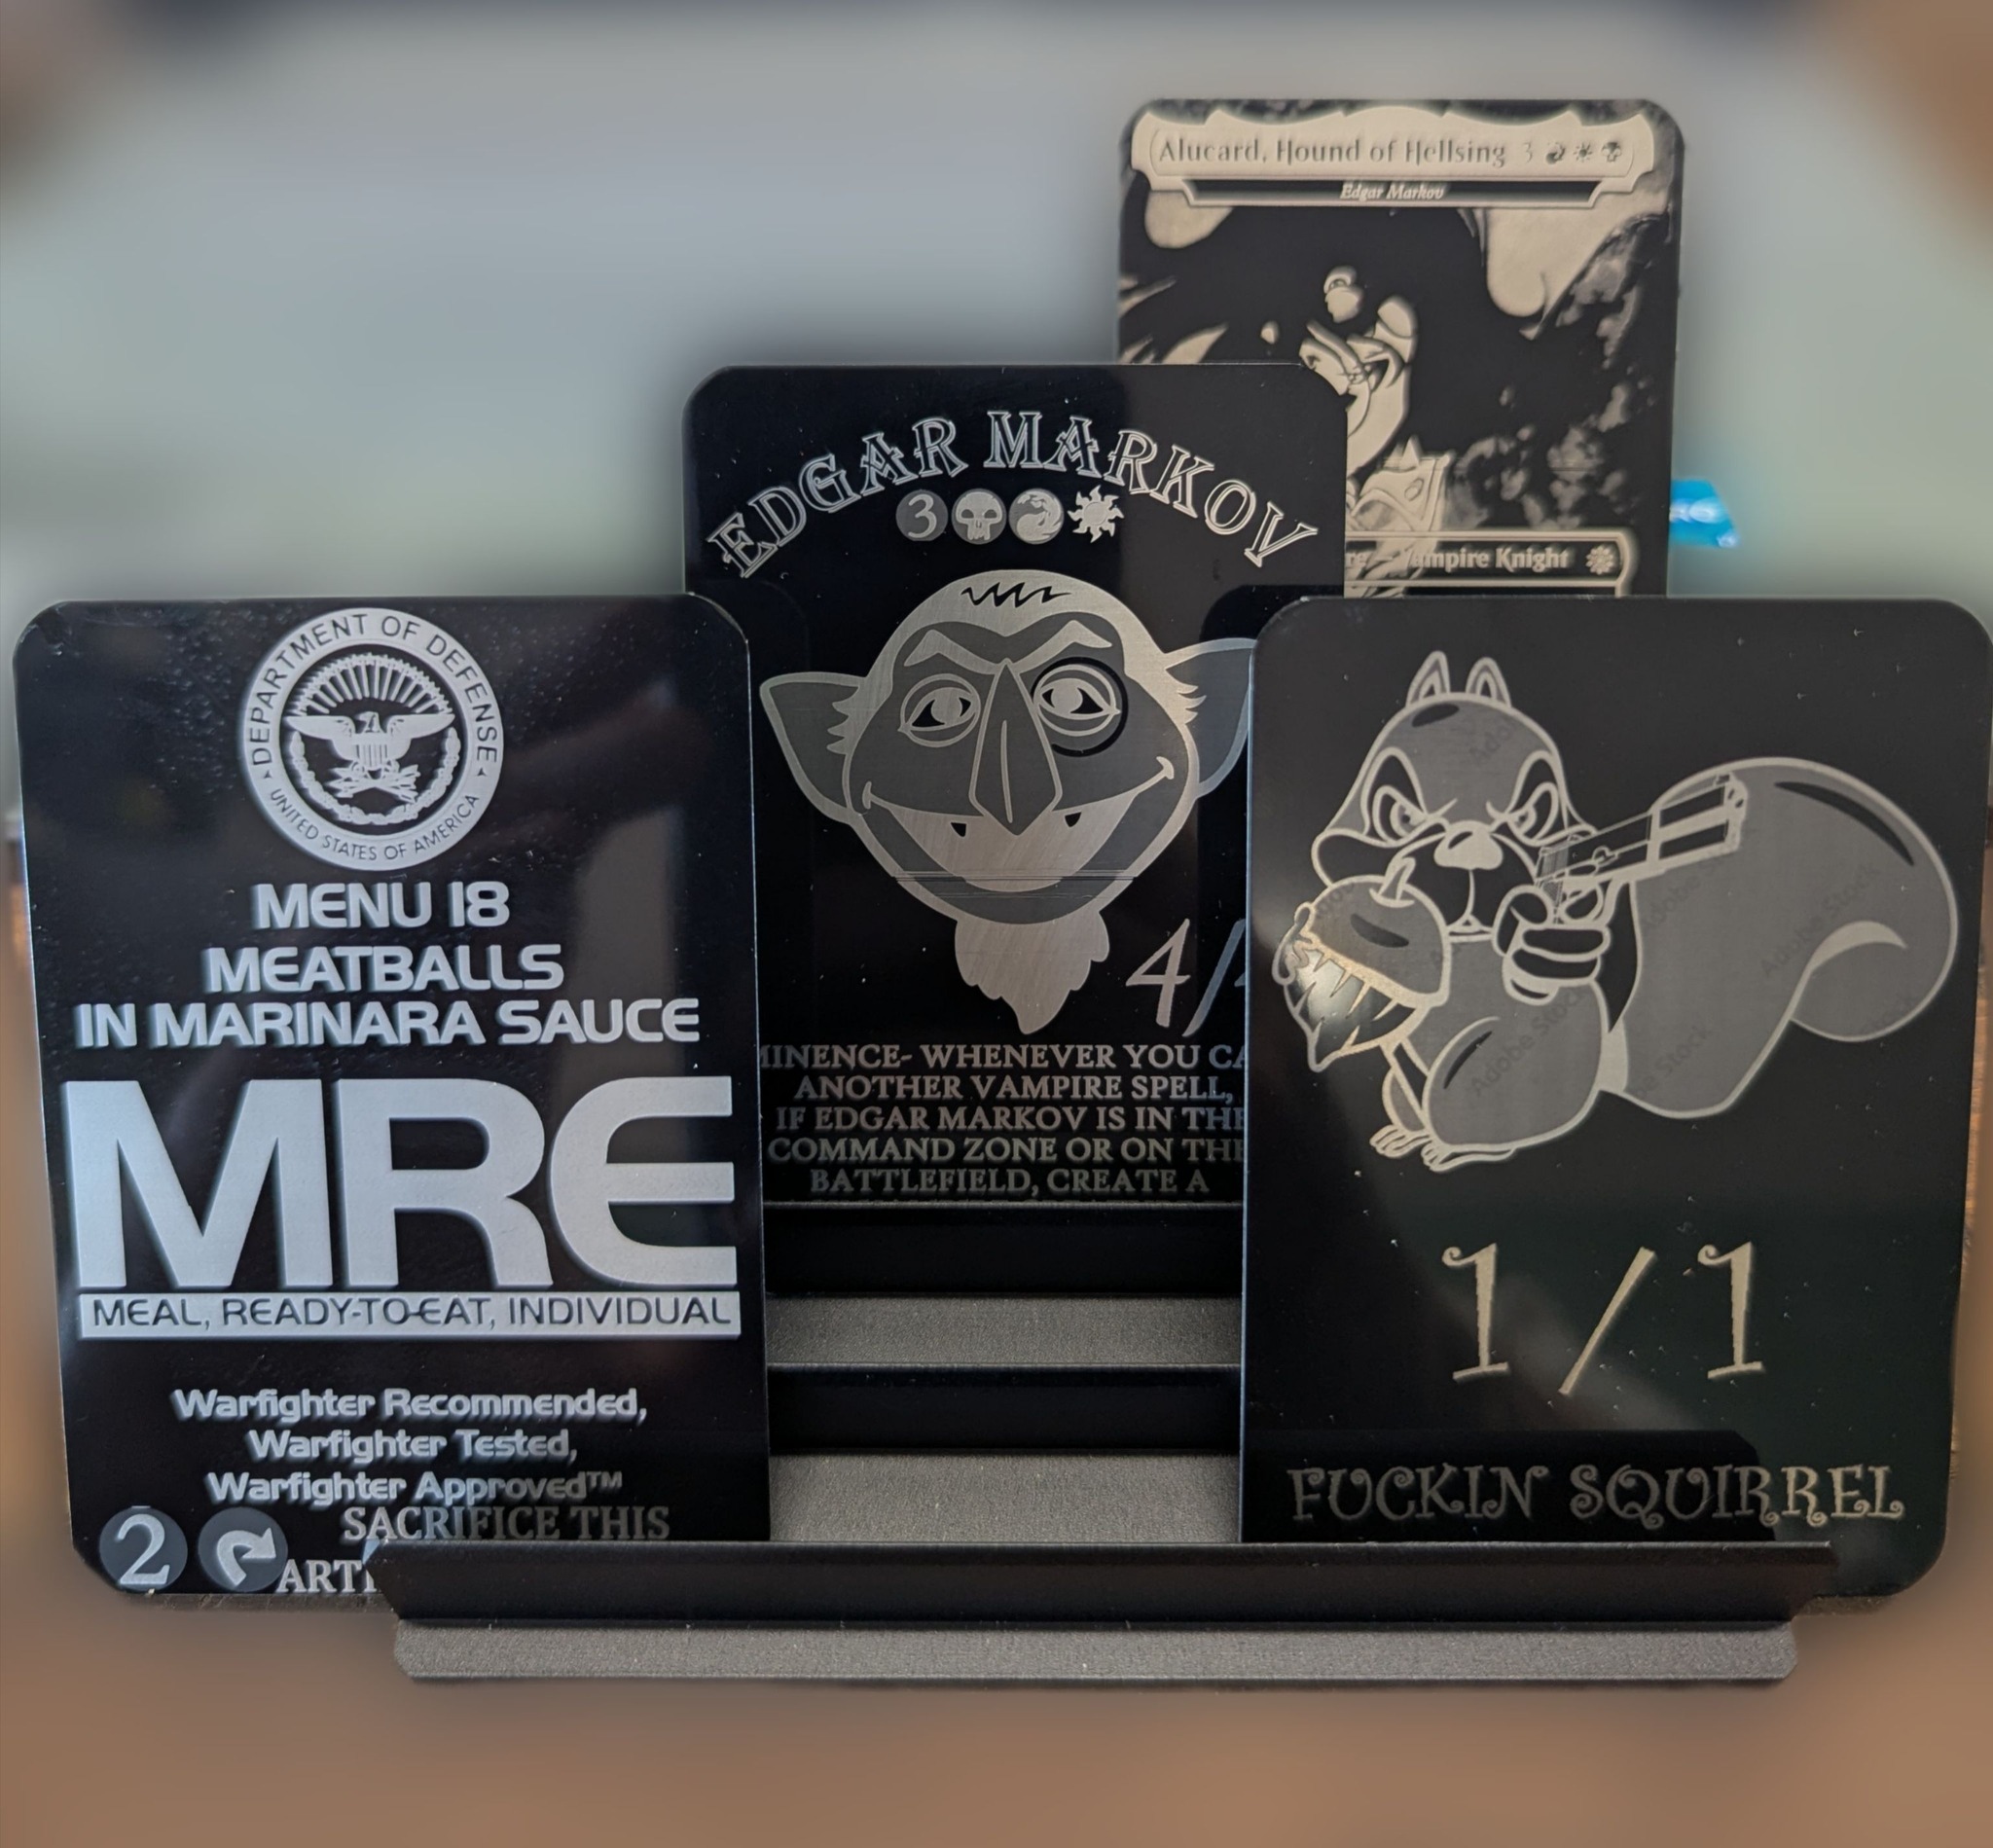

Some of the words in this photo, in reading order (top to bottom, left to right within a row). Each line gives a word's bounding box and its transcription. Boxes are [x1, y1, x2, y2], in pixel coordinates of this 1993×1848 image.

[1158, 137, 1267, 164] Alucard,
[1276, 136, 1360, 166] Hound
[1369, 137, 1396, 163] of
[1404, 136, 1506, 168] Hellsing
[1340, 182, 1382, 201] Edgar
[1385, 182, 1446, 200] Markov
[707, 417, 968, 579] EDGAR
[983, 410, 1319, 568] MARKOV
[904, 493, 938, 539] 3
[1495, 547, 1570, 573] Knight
[249, 613, 369, 766] DEPARTMENT
[380, 615, 421, 641] OF
[424, 634, 498, 764] DEFENSE
[270, 788, 319, 841] UNITED
[322, 834, 378, 861] STATES
[383, 844, 408, 861] OF
[414, 794, 480, 854] AMERICA
[253, 881, 431, 929] MENU
[448, 880, 510, 927] 18
[204, 943, 564, 994] MEATBALLS
[1126, 918, 1246, 1036] 4/
[74, 1001, 138, 1048] IN
[151, 998, 487, 1047] MARINARA
[497, 997, 701, 1045] SAUCE
[919, 1043, 1117, 1069] WHENEVER
[1123, 1043, 1201, 1069] YOU
[794, 1075, 963, 1101] ANOTHER
[971, 1075, 1122, 1101] VAMPIRE
[1130, 1075, 1234, 1105] SPELL,
[777, 1105, 807, 1131] IF
[815, 1105, 930, 1131] EDGAR
[937, 1105, 1089, 1131] MARKOV
[1096, 1105, 1126, 1131] IS
[1134, 1105, 1175, 1131] IN
[767, 1137, 957, 1163] COMMAND
[962, 1137, 1059, 1163] ZONE
[1066, 1137, 1111, 1163] OR
[1120, 1137, 1175, 1163] ON
[60, 1075, 738, 1289] MRE
[809, 1168, 1040, 1197] BATTLEFIELD,
[1047, 1168, 1179, 1194] CREATE
[1185, 1168, 1211, 1194] A
[93, 1297, 211, 1331] MEAL,
[509, 1295, 732, 1326] INDIVIDUAL
[169, 1389, 377, 1425] Warfighter
[383, 1388, 648, 1423] Recommended,
[245, 1430, 448, 1465] Warfighter
[456, 1428, 579, 1463] Tested,
[203, 1471, 407, 1506] Warfighter
[1568, 1463, 1906, 1531] SQUIRREL
[341, 1505, 562, 1542] SACRIFICE
[576, 1505, 670, 1541] THIS
[115, 1513, 170, 1586] 2
